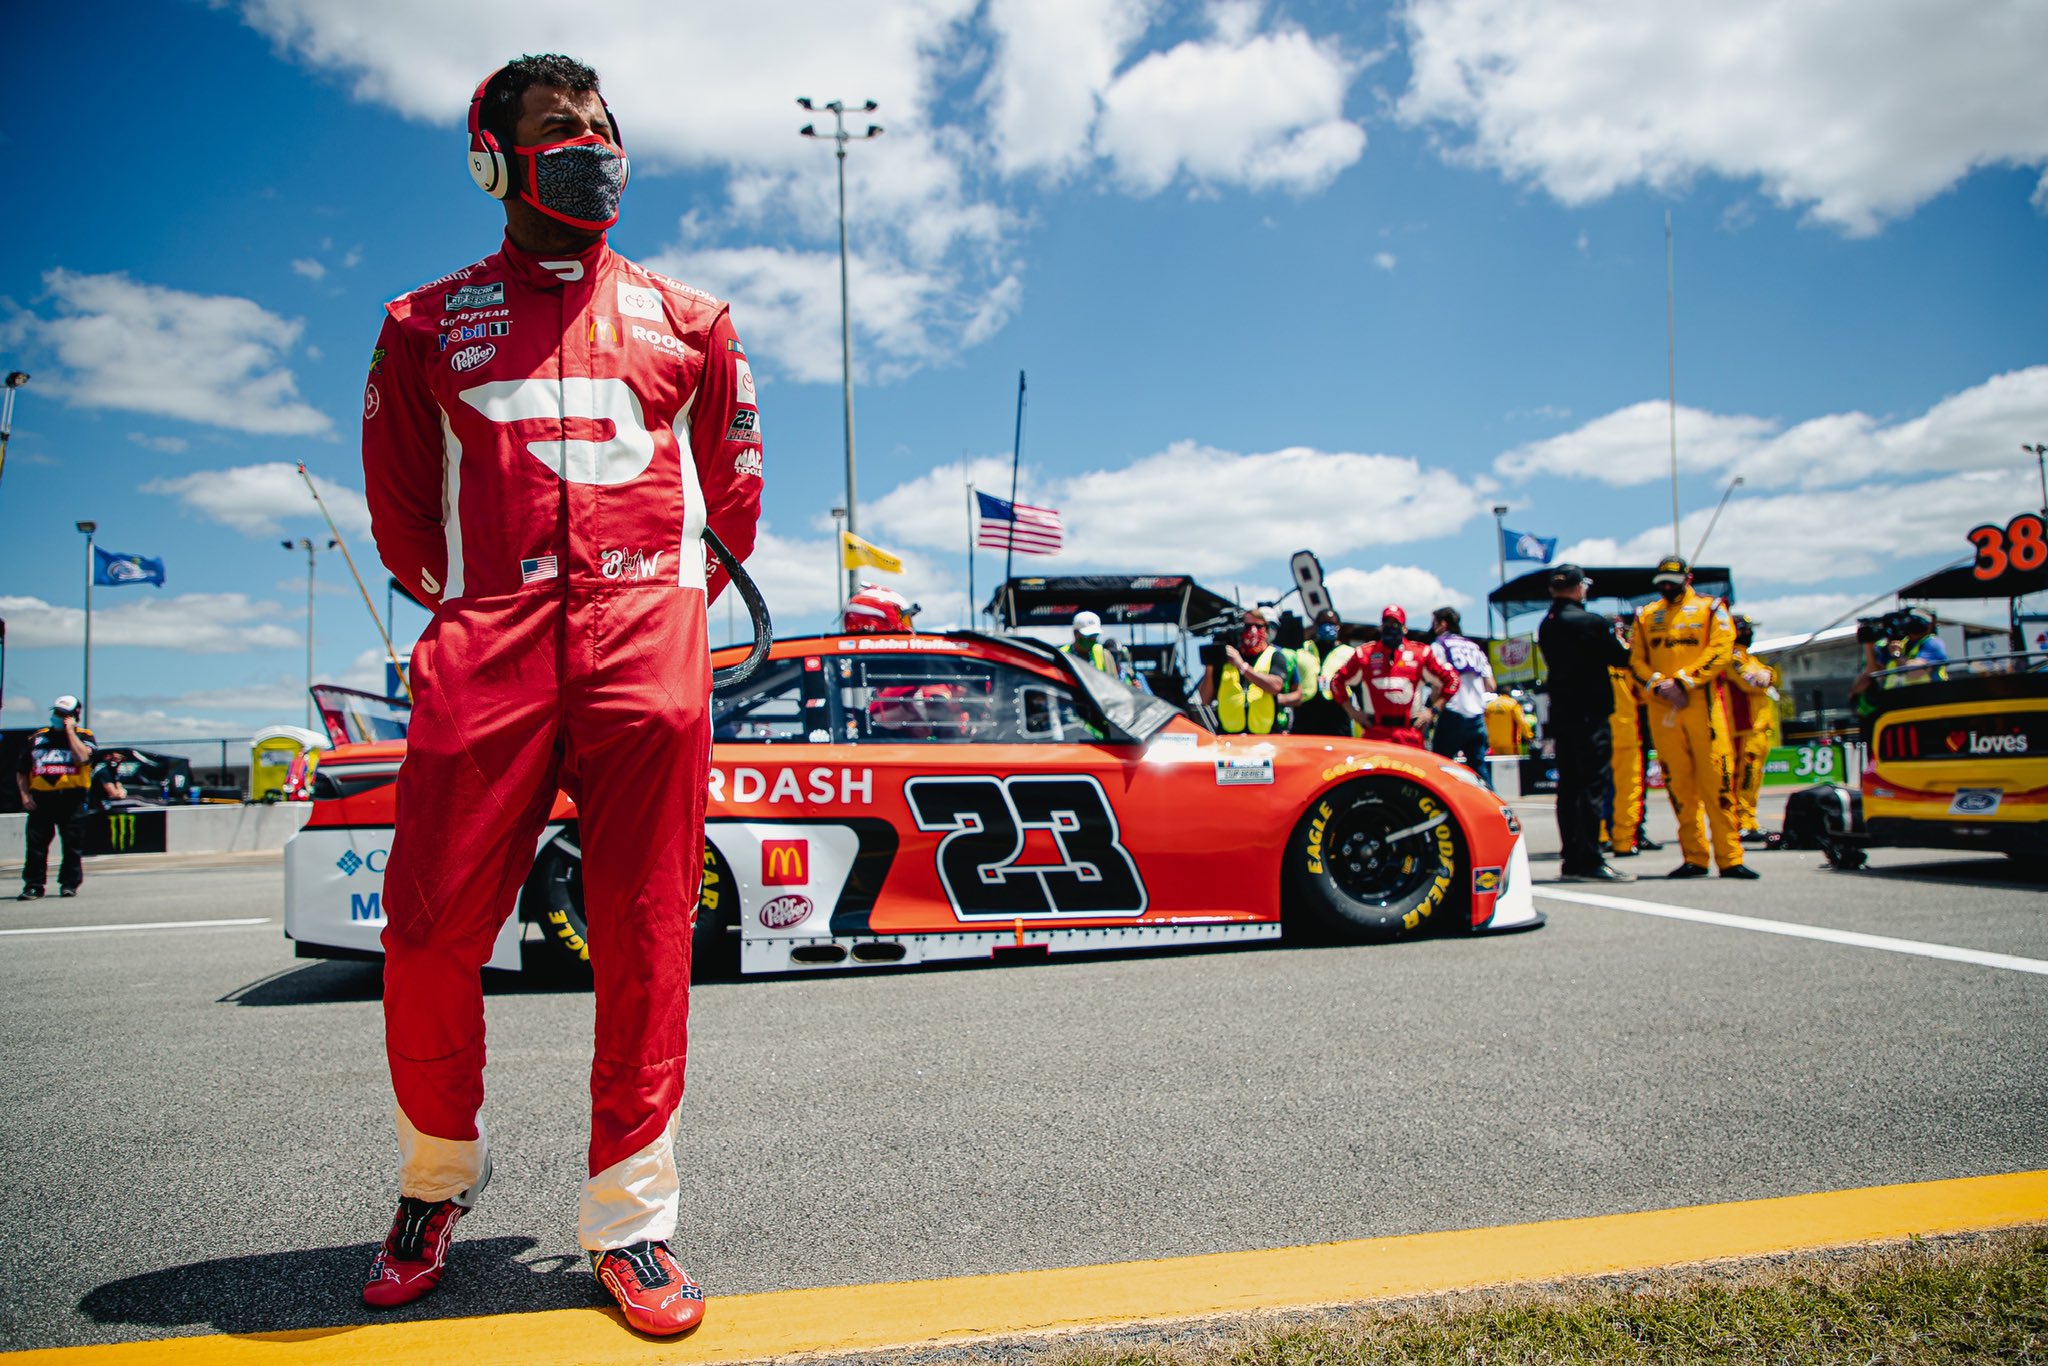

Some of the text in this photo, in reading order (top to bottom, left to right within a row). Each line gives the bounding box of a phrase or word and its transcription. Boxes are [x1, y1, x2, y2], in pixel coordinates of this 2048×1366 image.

[459, 285, 495, 296] NASCAR
[455, 347, 493, 372] Pepper
[465, 345, 482, 357] Dr
[731, 409, 756, 430] 23
[1969, 514, 2048, 580] 38
[1794, 746, 1834, 776] 38
[903, 774, 1149, 922] 23
[1307, 800, 1333, 875] EAGLE
